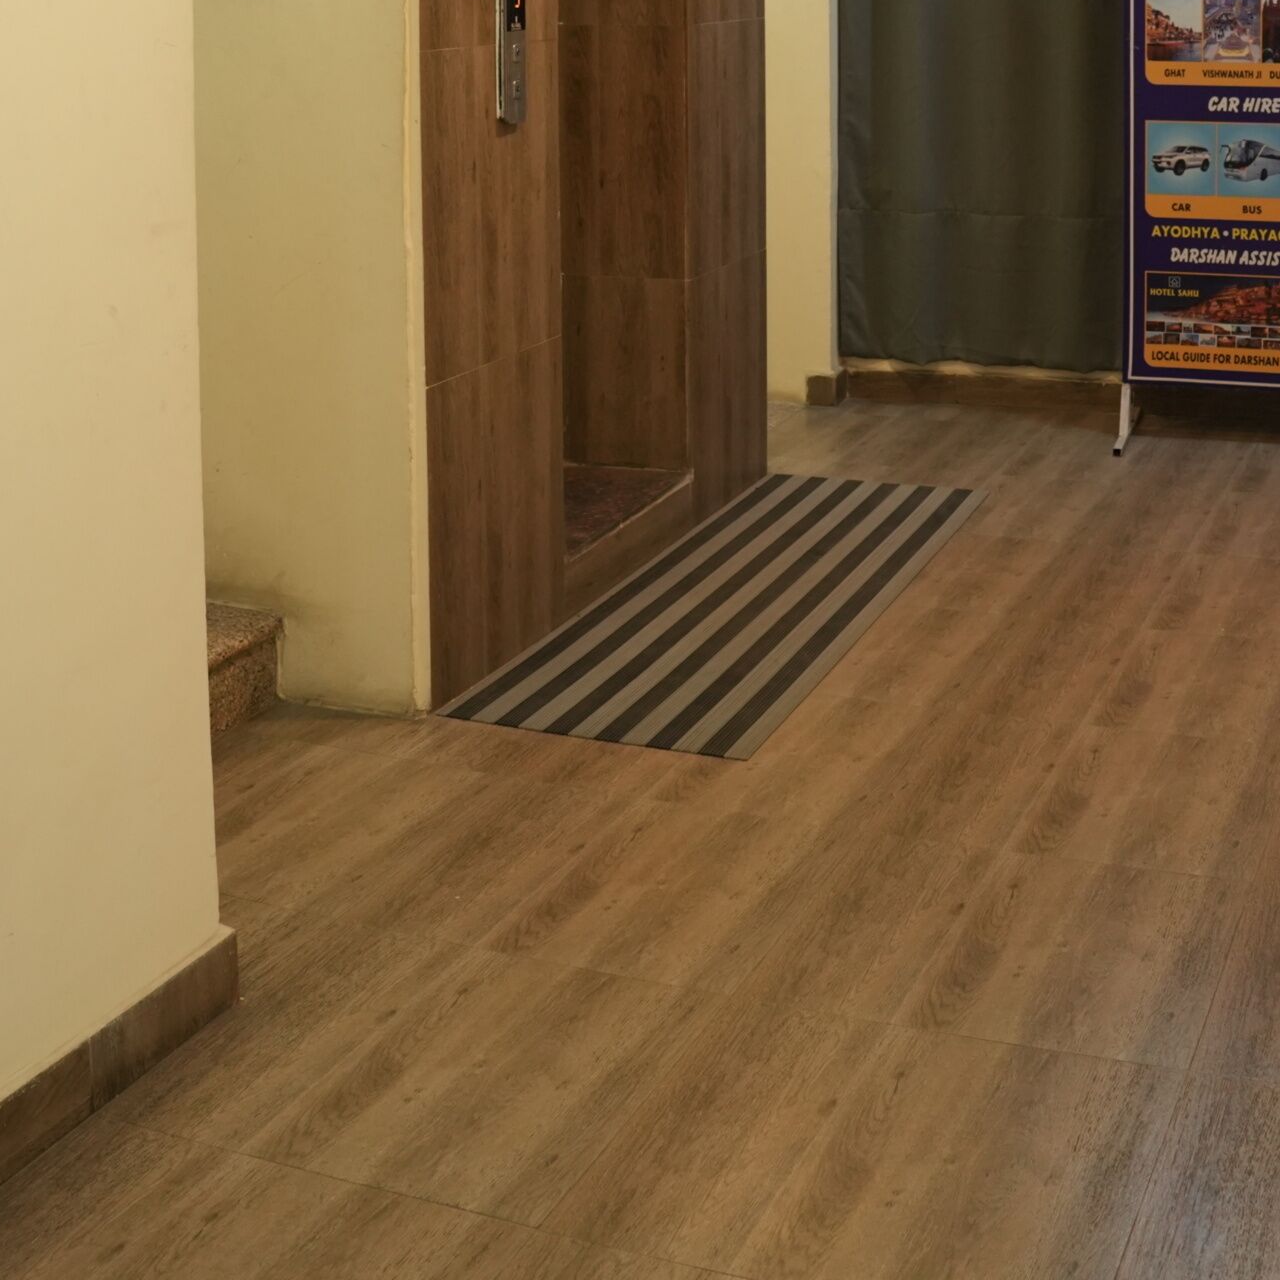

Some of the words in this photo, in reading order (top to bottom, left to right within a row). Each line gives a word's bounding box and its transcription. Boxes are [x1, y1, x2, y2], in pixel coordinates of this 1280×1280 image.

[1164, 68, 1186, 78] GHAT
[1202, 69, 1254, 80] VISHWANATH
[1255, 70, 1262, 80] JI
[1208, 96, 1240, 114] CAR
[1171, 202, 1191, 213] CAR
[1242, 205, 1262, 215] BUS
[1151, 226, 1220, 240] AYODHYA
[1170, 247, 1235, 265] DARSHAN
[1150, 288, 1175, 297] HOTEL
[1177, 289, 1199, 298] SAHU
[1151, 351, 1180, 361] LOCAL
[1183, 352, 1210, 363] GUIDE
[1213, 353, 1229, 365] FOR
[1231, 354, 1280, 367] DARSHAN
